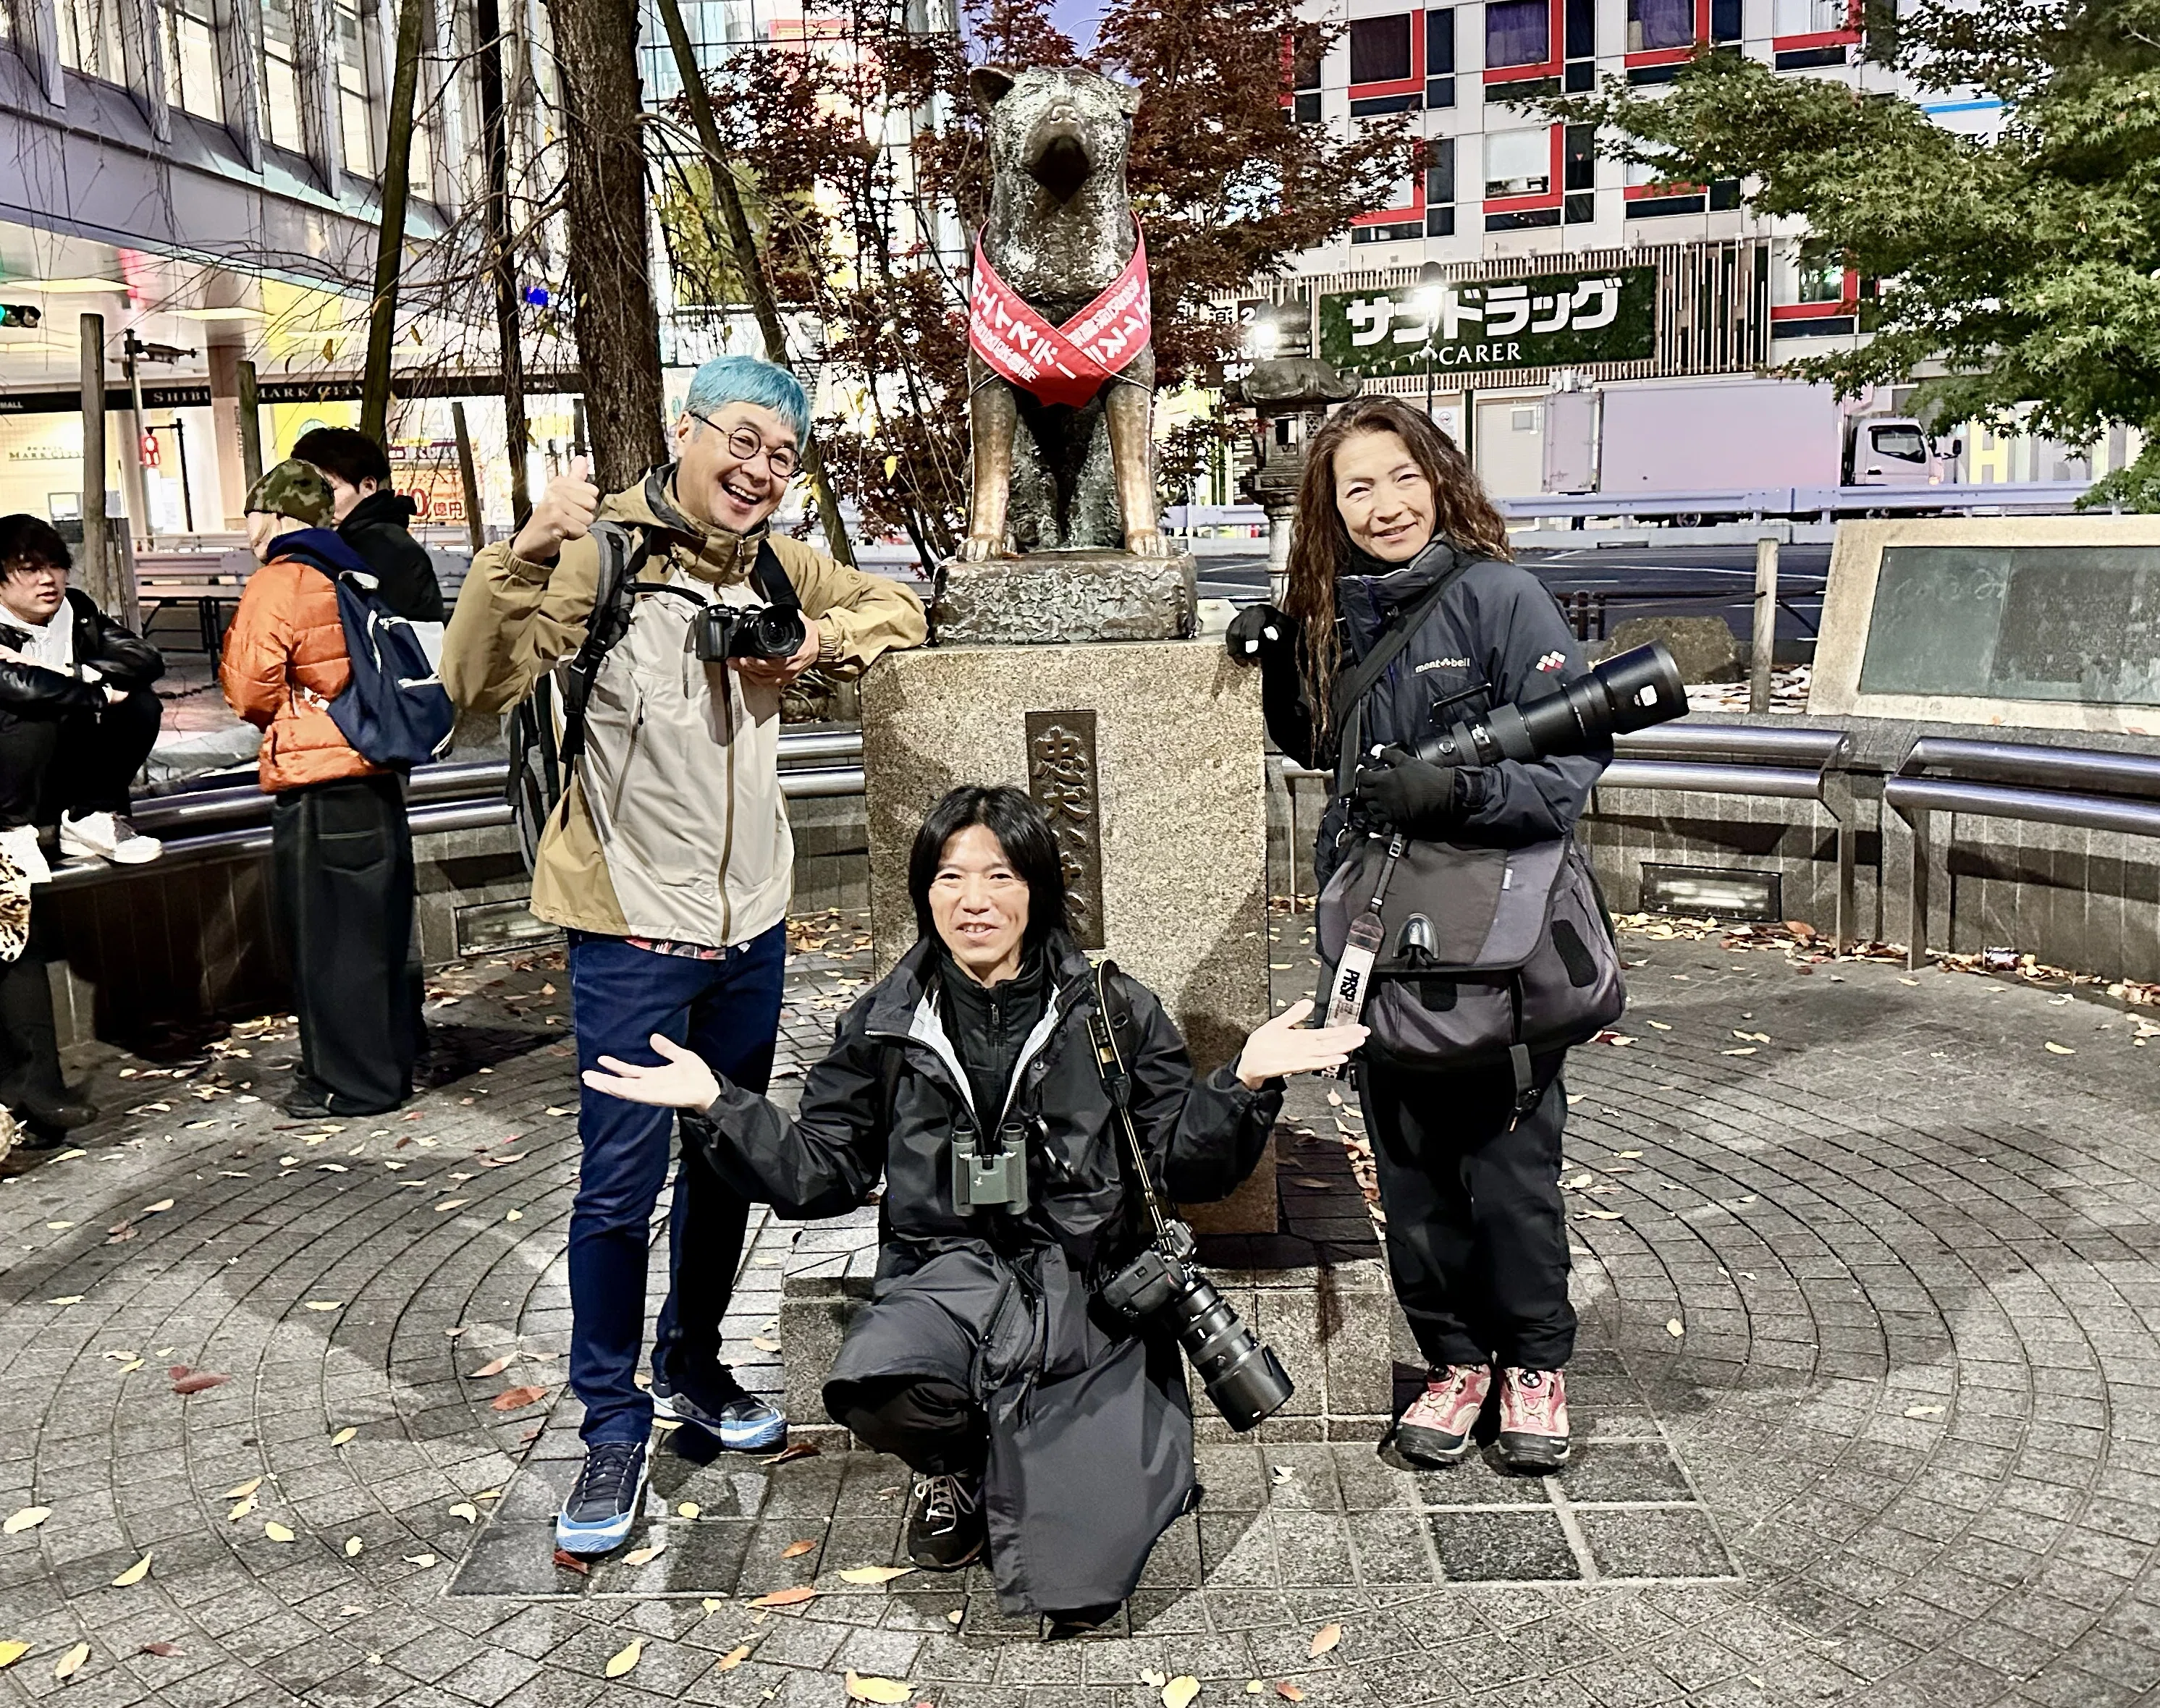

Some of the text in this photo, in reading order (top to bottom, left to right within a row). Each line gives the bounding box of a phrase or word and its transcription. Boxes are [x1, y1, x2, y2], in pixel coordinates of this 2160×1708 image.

[1346, 277, 1622, 346] サンドラッグ
[1439, 342, 1522, 365] CARER
